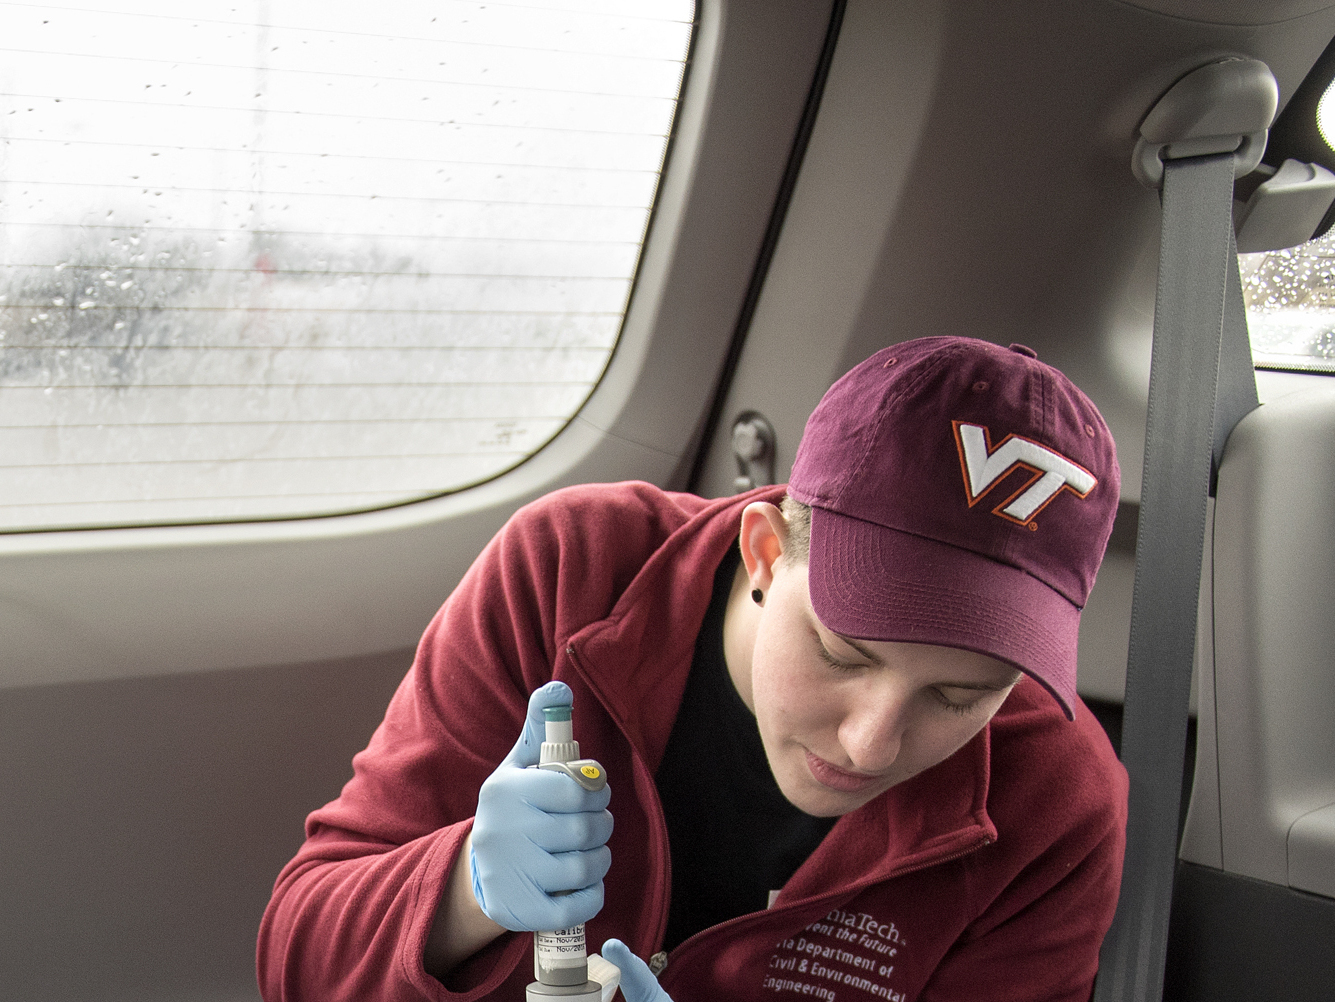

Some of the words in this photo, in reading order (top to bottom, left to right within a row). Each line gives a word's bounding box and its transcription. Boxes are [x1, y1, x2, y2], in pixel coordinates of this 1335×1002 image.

[952, 420, 1098, 526] VT
[776, 938, 795, 949] ia
[796, 938, 876, 971] Department
[878, 965, 894, 978] of
[836, 927, 857, 942] the
[858, 934, 898, 957] Future
[769, 955, 797, 971] Civil
[798, 958, 809, 973] &
